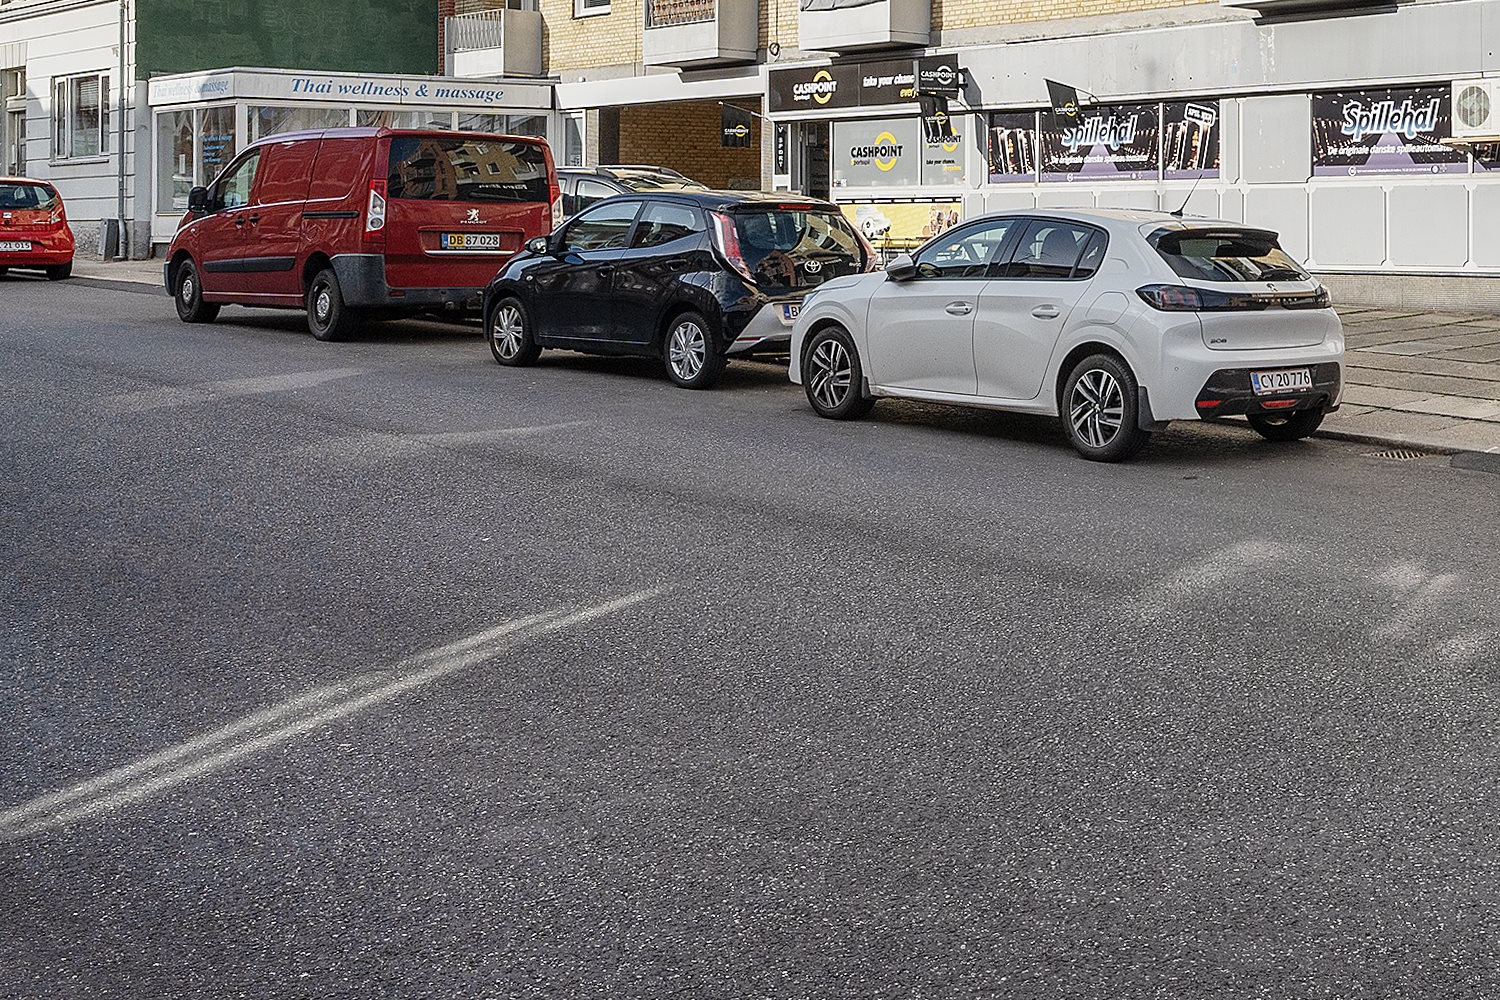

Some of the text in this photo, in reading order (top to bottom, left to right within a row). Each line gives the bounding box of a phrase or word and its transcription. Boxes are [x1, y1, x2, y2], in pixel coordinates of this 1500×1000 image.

[862, 75, 878, 87] take
[877, 75, 894, 88] your
[921, 70, 956, 79] CASHPOINT
[292, 78, 504, 103] Thai wellness & massage
[793, 80, 837, 95] CASHPOINT
[1341, 98, 1441, 142] Spillehal
[1061, 115, 1139, 150] Spillehal
[850, 145, 903, 158] CASHPOINT
[1327, 146, 1339, 155] De
[1339, 145, 1369, 156] originale
[1370, 145, 1396, 154] danske
[449, 235, 499, 246] DB 87 028
[1260, 371, 1310, 388] CY 20 776
